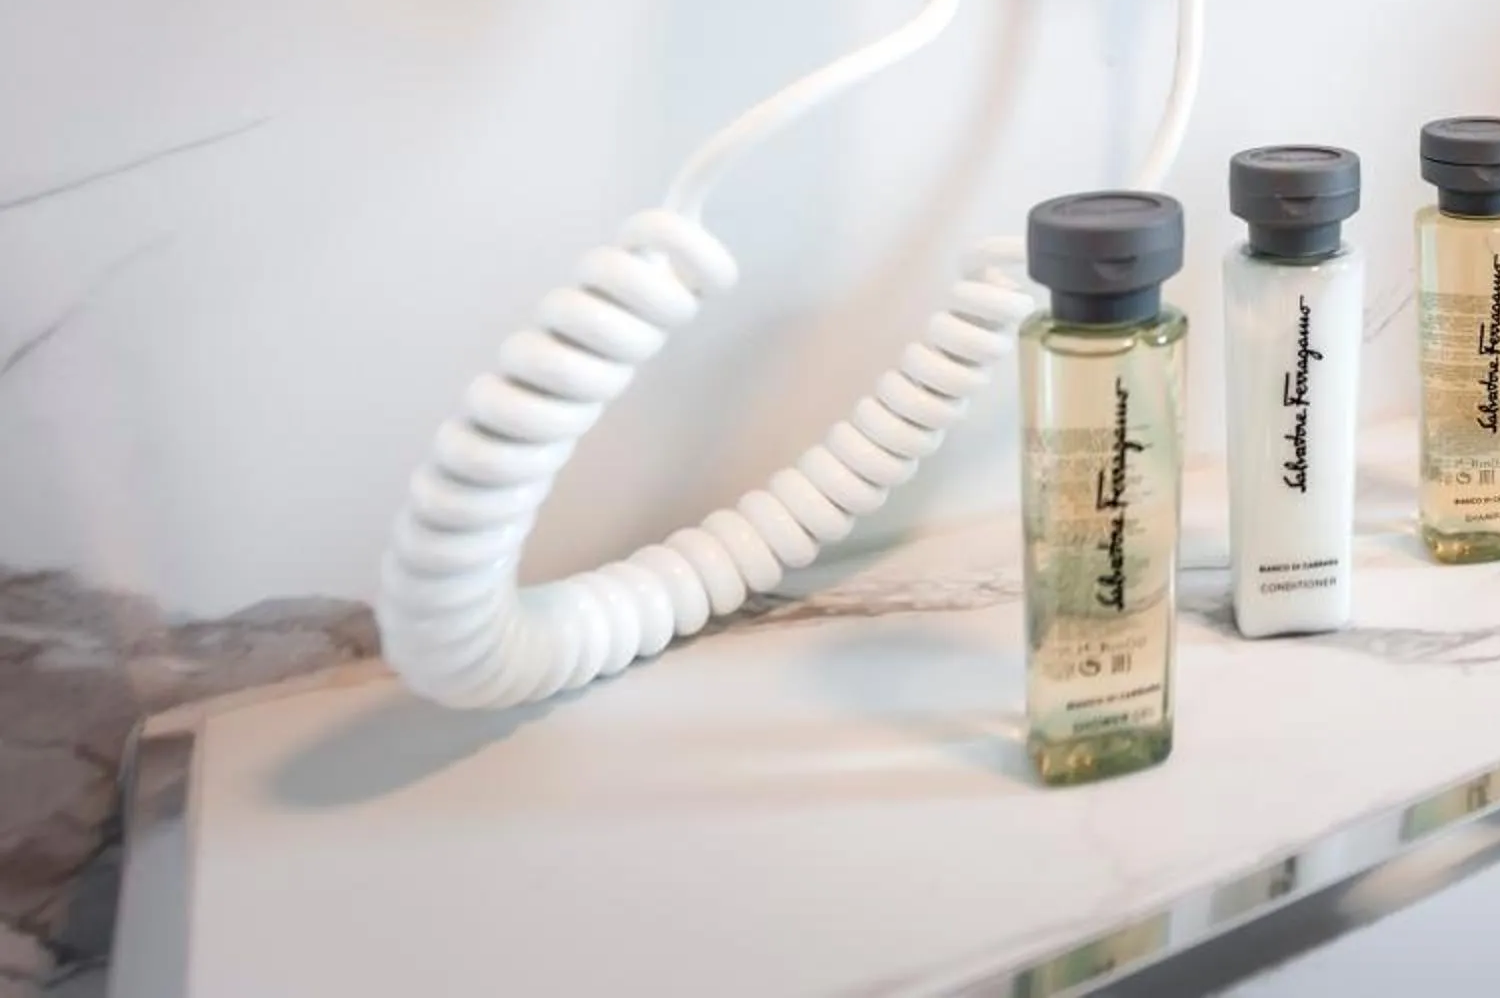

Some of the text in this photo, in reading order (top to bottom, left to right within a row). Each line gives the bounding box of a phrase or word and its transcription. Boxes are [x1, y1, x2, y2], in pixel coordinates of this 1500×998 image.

[1283, 295, 1324, 493] Salvatore Ferragamo
[1477, 358, 1500, 434] Salvatore
[1095, 376, 1145, 613] Salvatore Ferragamo
[1260, 576, 1337, 595] CONDITIONER
